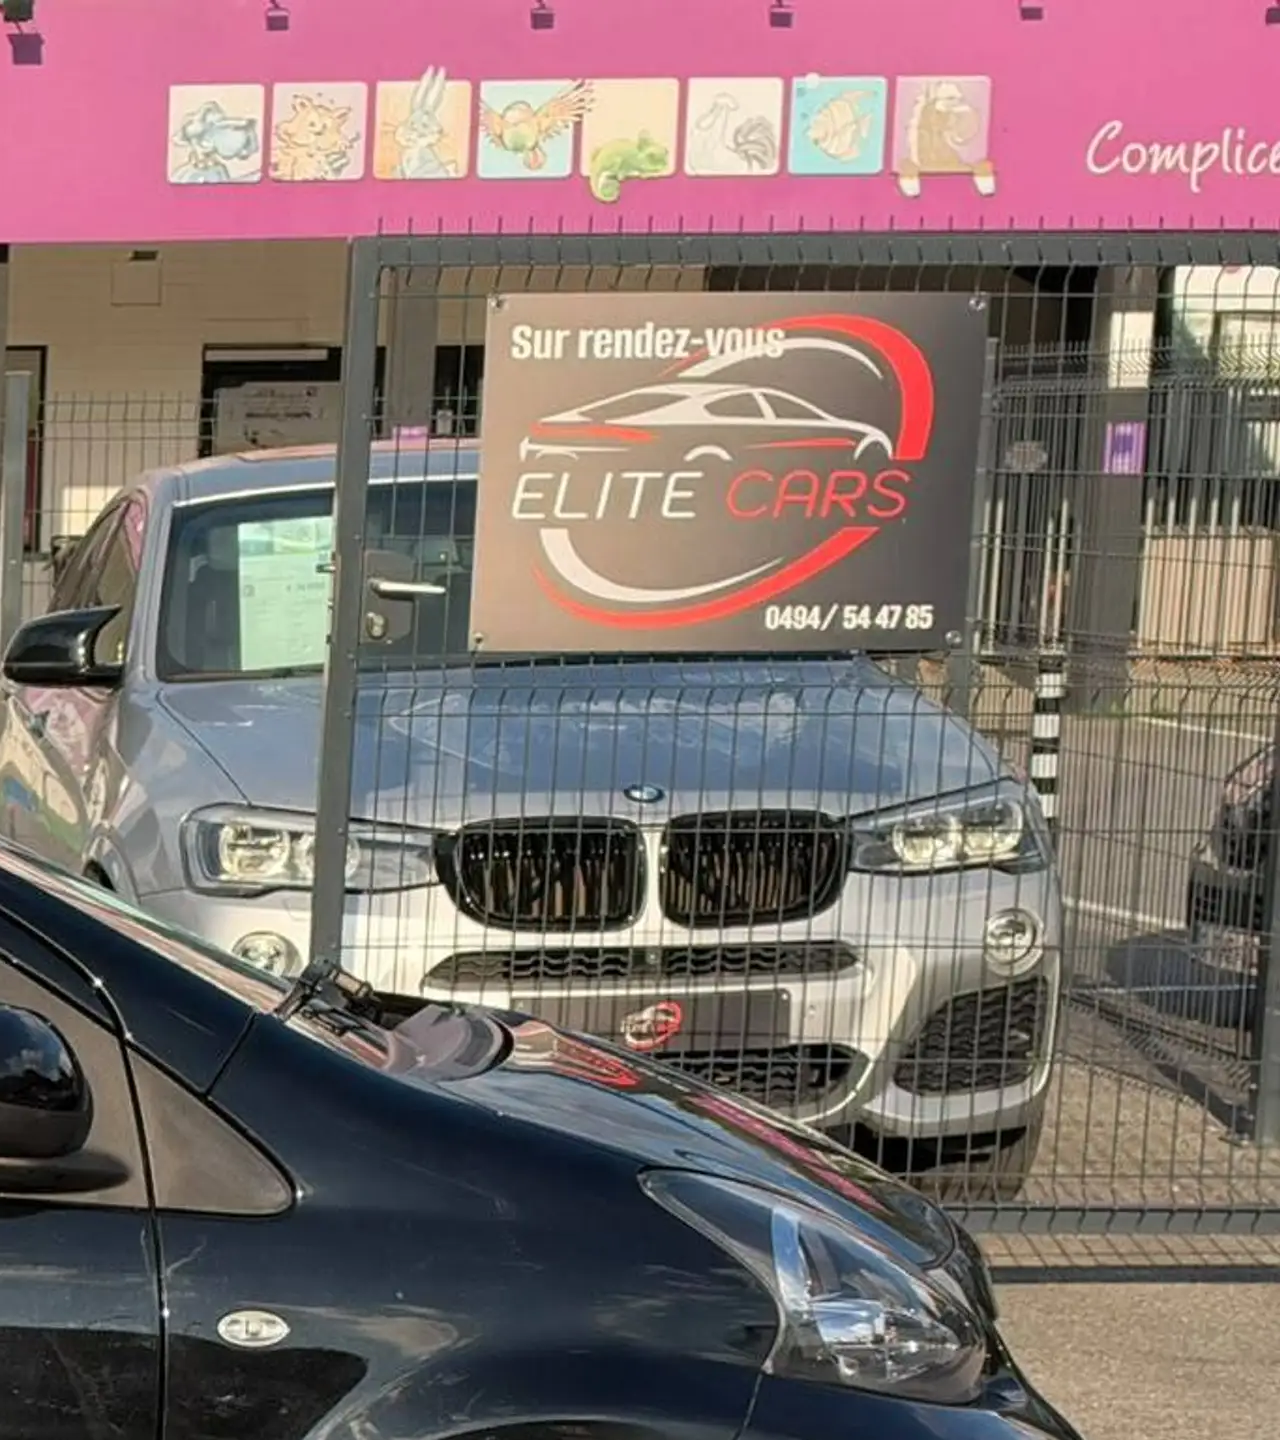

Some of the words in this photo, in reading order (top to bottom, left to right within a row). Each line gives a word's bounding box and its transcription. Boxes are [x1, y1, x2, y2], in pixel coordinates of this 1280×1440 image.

[511, 325, 570, 359] Sur
[580, 325, 786, 360] rendez-vous
[511, 470, 704, 520] ELITE
[726, 469, 912, 518] CARS
[764, 604, 838, 632] 0494/
[843, 605, 873, 631] 54
[877, 605, 903, 630] 47
[905, 605, 934, 630] 85
